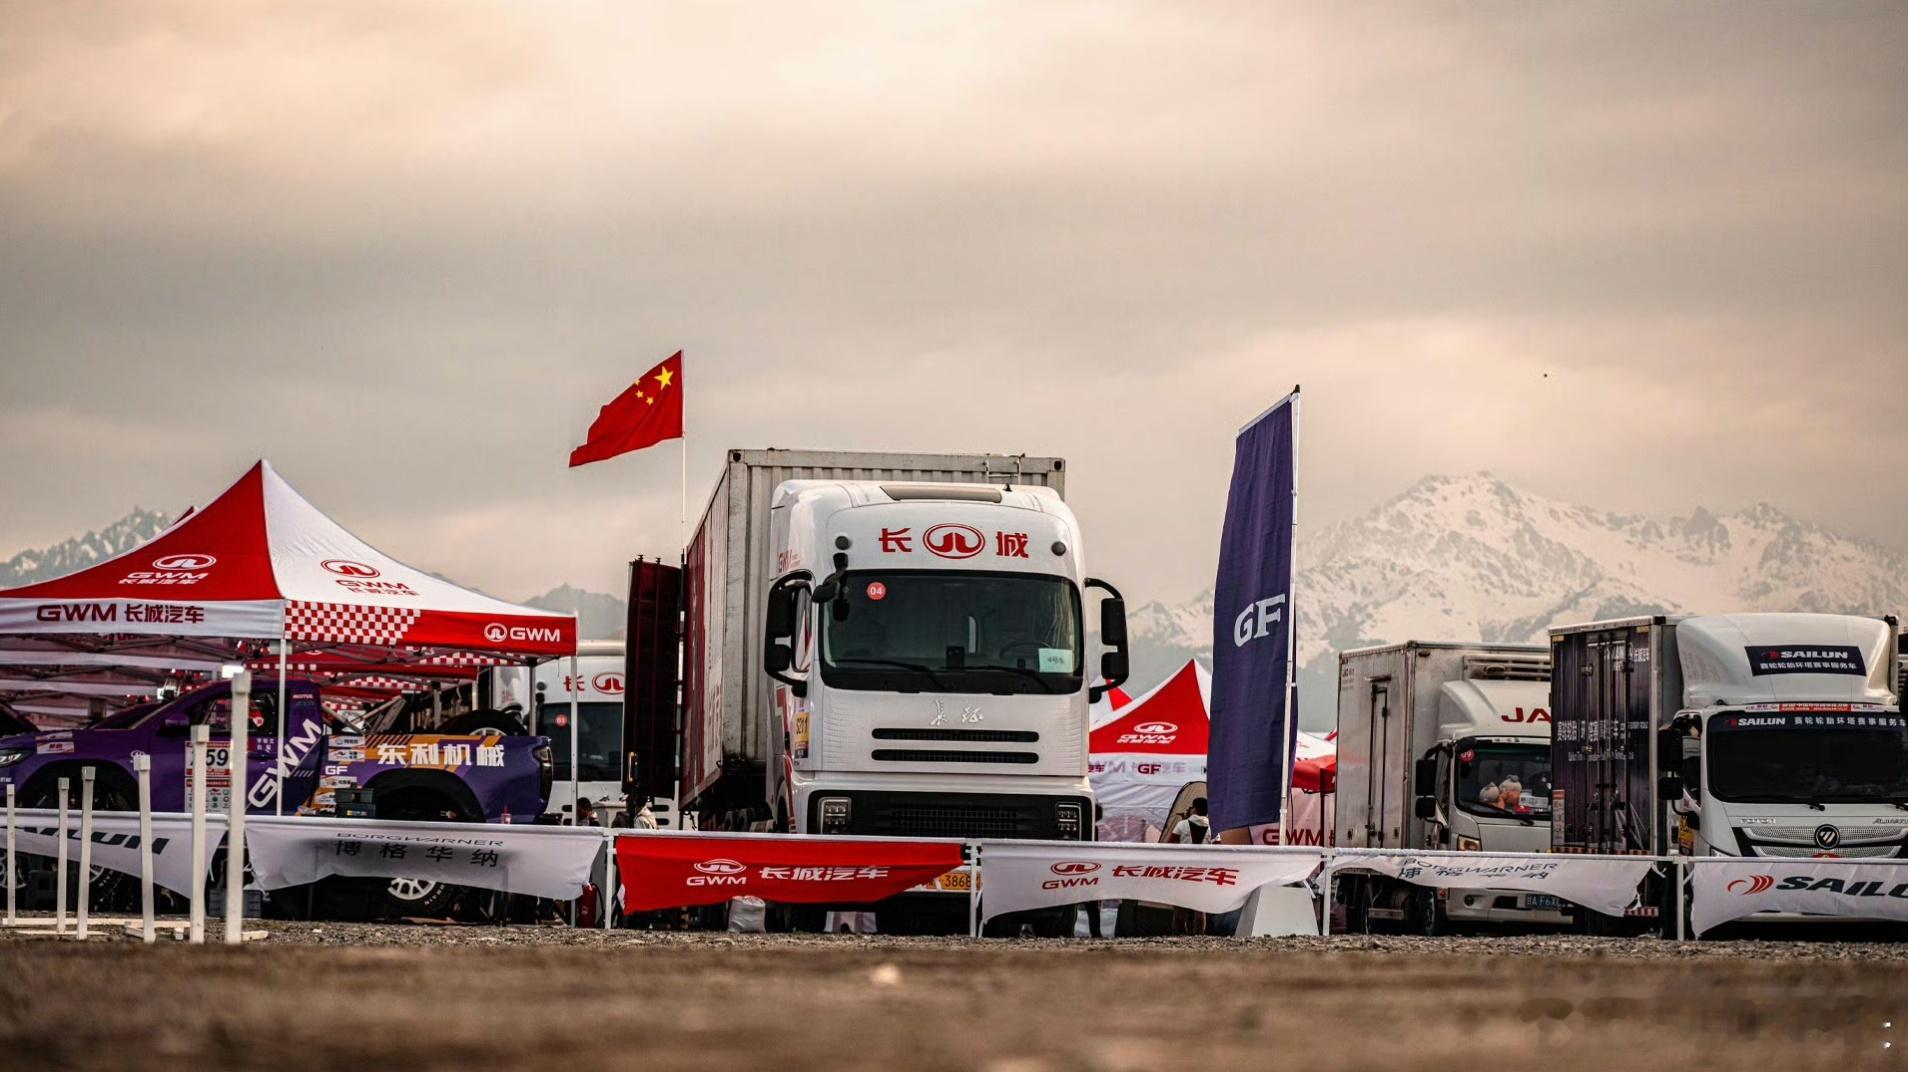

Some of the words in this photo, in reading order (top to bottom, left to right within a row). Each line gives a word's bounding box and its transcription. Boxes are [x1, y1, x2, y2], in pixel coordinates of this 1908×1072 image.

[878, 527, 912, 553] 长
[995, 531, 1029, 559] 城
[336, 579, 410, 589] GWM
[870, 586, 883, 595] 04
[36, 603, 117, 622] GWM
[124, 603, 205, 623] 长城汽车
[1233, 593, 1286, 647] GF
[509, 626, 561, 642] GWM
[1780, 651, 1849, 659] SAILUN
[563, 675, 585, 692] 长
[1738, 717, 1786, 726] SAILUN
[377, 742, 505, 767] 东利机械
[247, 718, 323, 808] GWM
[324, 765, 349, 775] GF
[1137, 763, 1161, 774] GF
[336, 832, 504, 847] BORGWARNER
[1262, 829, 1322, 846] GWM
[334, 840, 499, 868] 博格华纳
[686, 876, 747, 886] GWM
[758, 866, 890, 881] 长城汽车
[1112, 864, 1240, 886] 长城汽车
[1042, 877, 1099, 890] GWM
